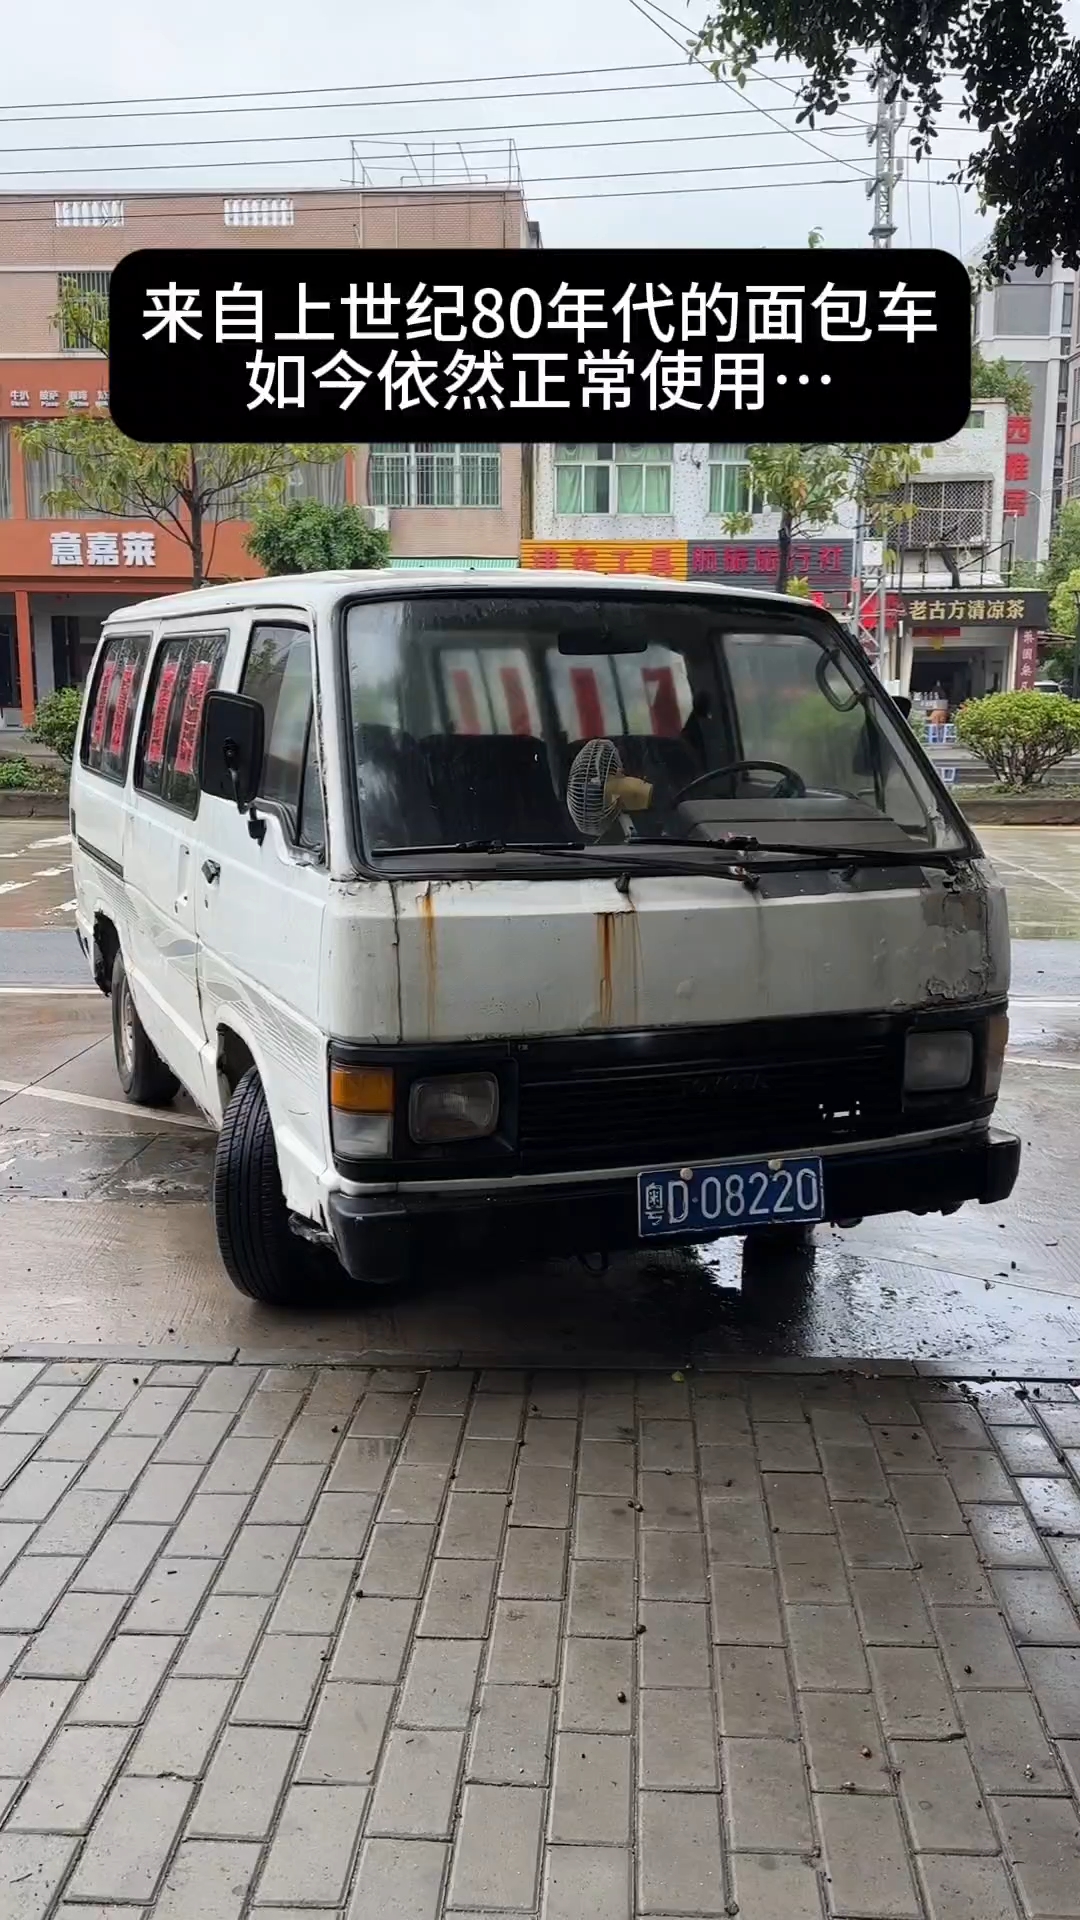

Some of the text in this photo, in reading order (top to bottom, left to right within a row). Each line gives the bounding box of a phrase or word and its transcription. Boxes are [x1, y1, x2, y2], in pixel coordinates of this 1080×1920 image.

[50, 531, 156, 567] 意嘉莱
[909, 599, 1025, 620] 老古方清凉茶
